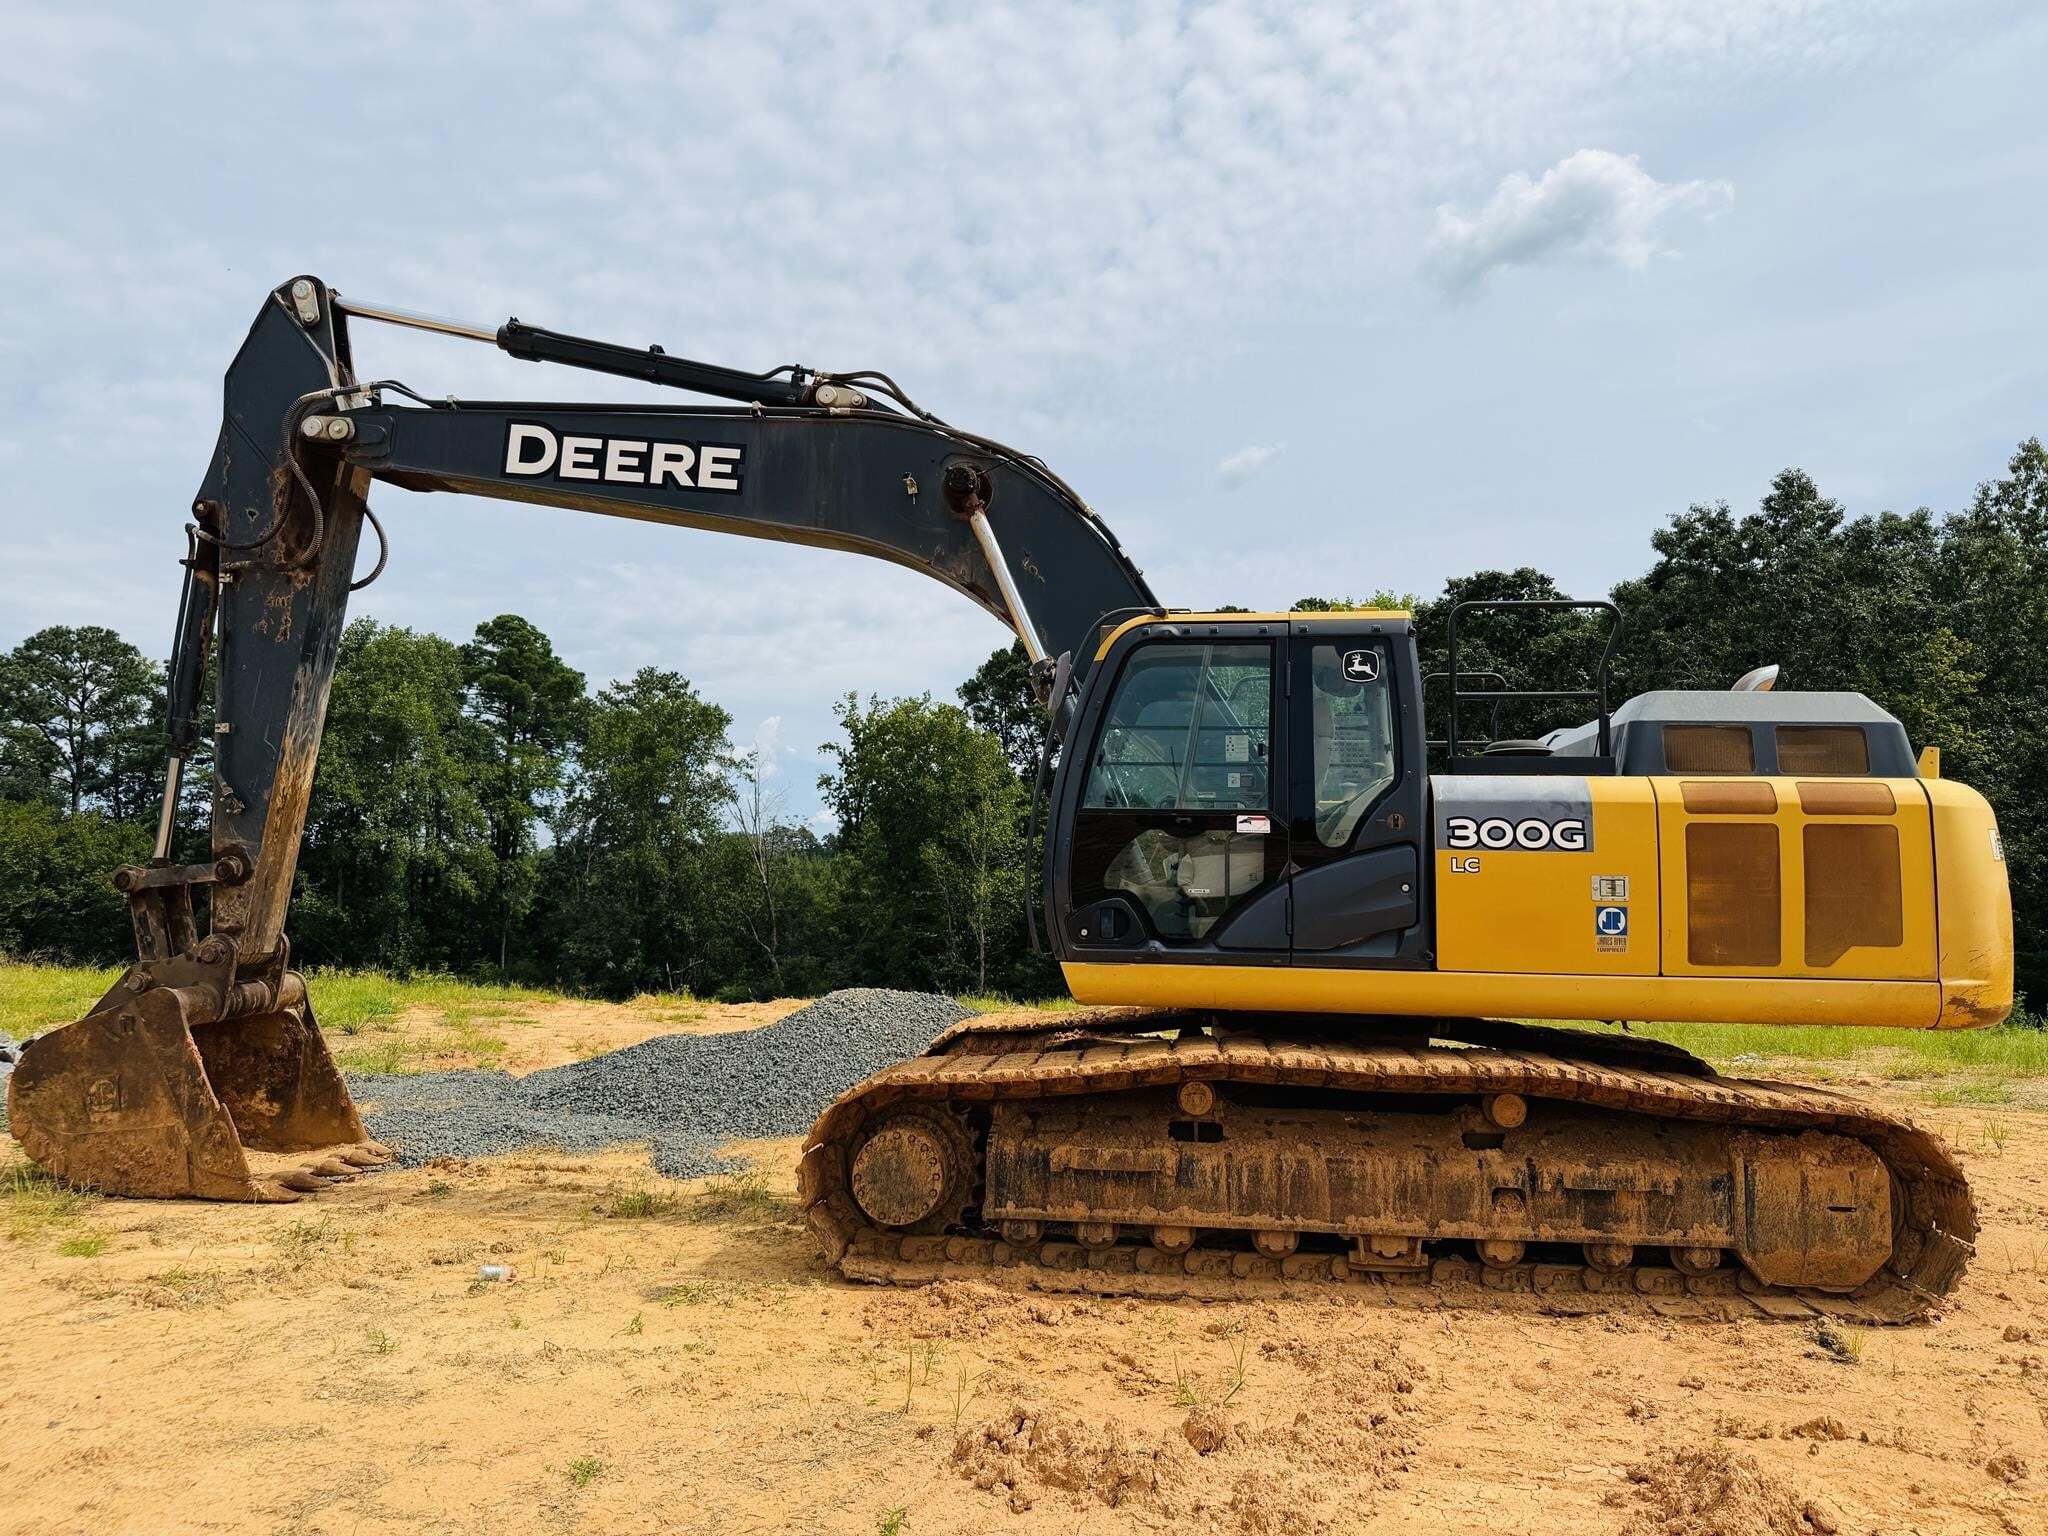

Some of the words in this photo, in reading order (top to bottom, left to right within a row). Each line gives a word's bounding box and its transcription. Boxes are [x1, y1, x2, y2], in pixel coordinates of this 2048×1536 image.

[505, 423, 742, 490] DEERE
[1448, 817, 1586, 850] 300G
[1451, 857, 1480, 872] LC
